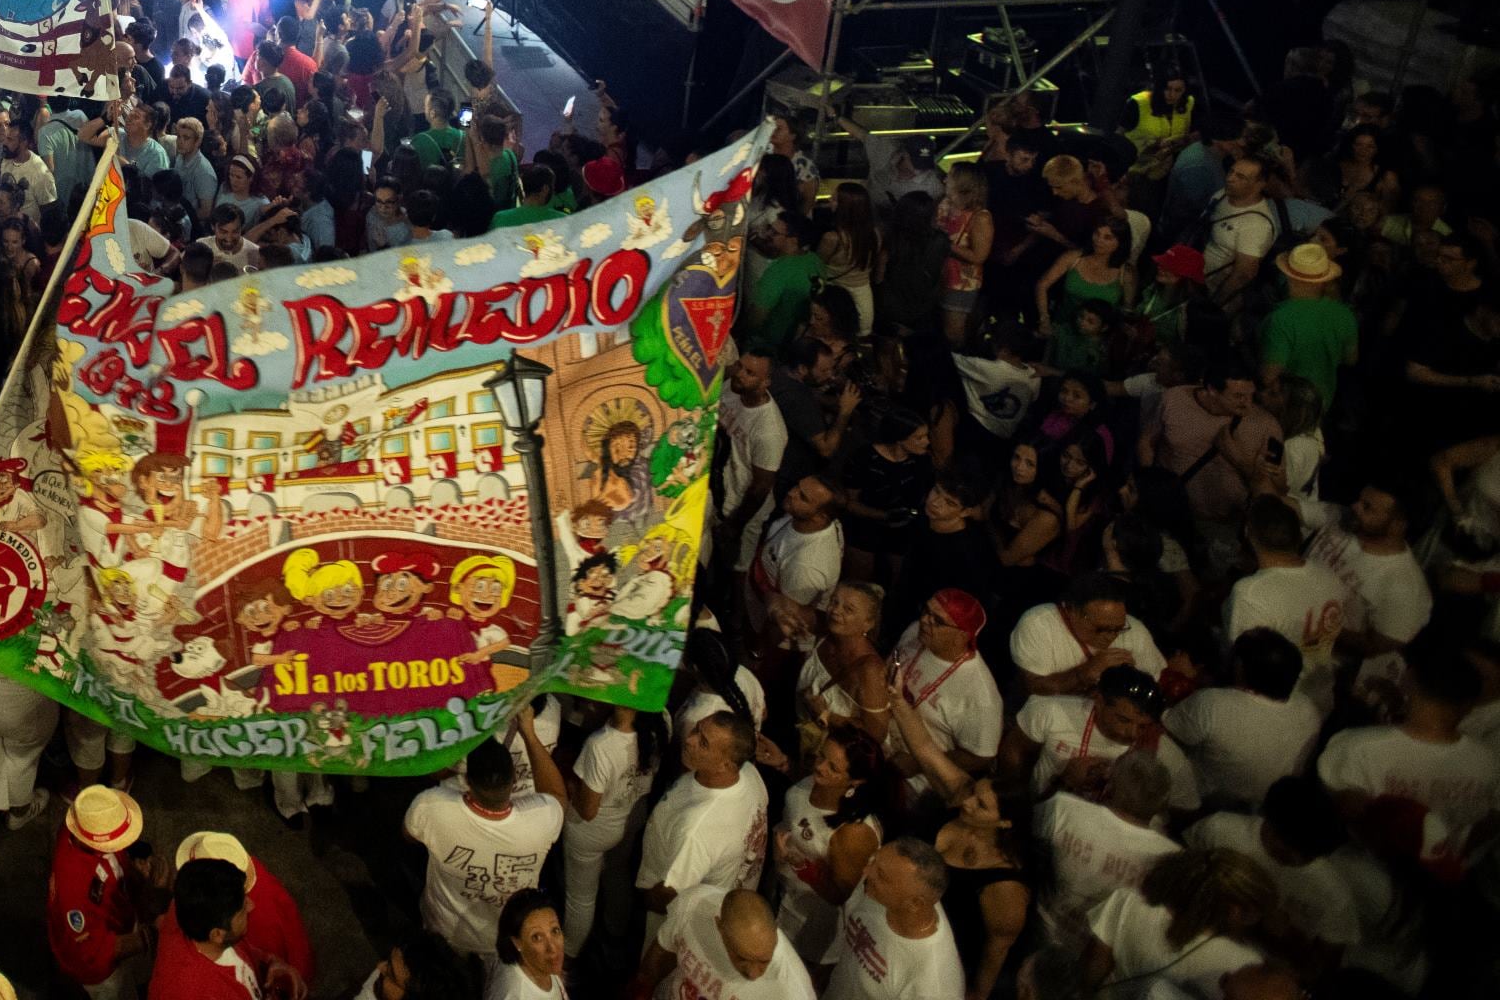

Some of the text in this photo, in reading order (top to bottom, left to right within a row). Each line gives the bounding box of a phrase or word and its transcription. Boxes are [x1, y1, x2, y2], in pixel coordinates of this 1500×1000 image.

[156, 310, 260, 392] EL
[283, 248, 651, 390] REMEDIO
[312, 673, 327, 694] a
[334, 670, 367, 694] los
[368, 656, 466, 692] TOROS
[357, 696, 512, 769] FELIZ
